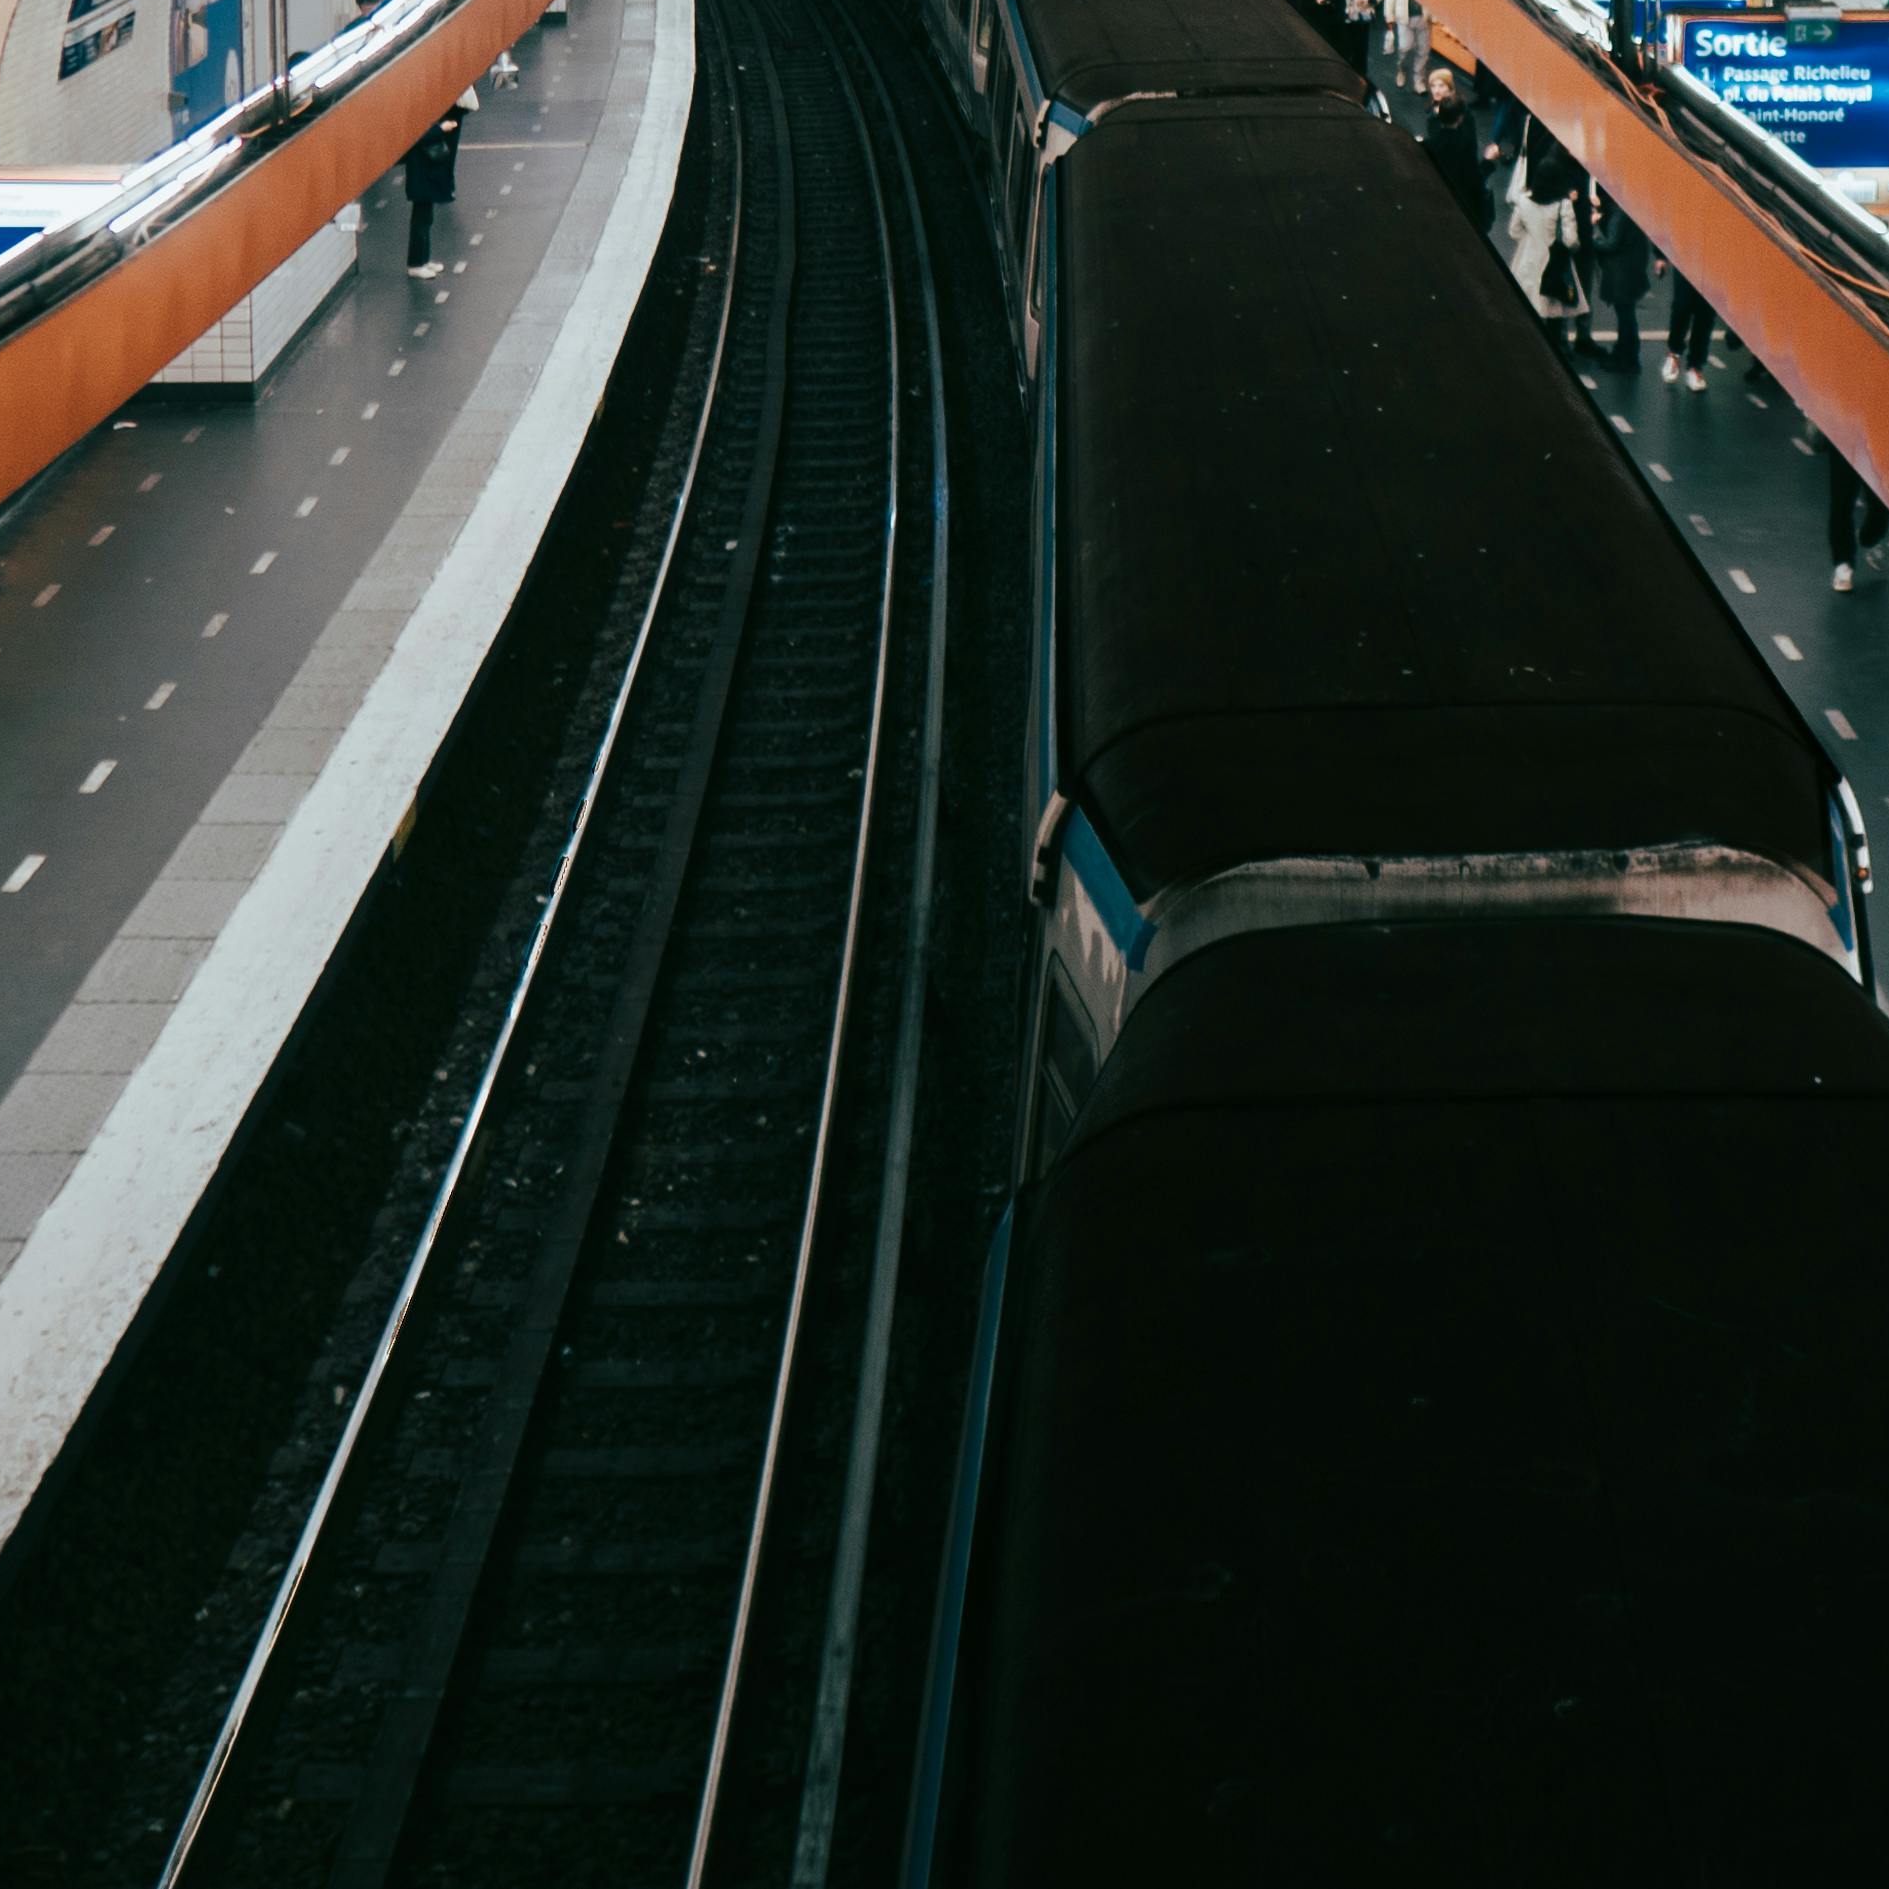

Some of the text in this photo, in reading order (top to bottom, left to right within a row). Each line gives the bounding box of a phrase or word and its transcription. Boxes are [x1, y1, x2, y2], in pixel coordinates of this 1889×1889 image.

[1695, 29, 1788, 57] Sortie
[1723, 65, 1788, 86] Passage
[1793, 65, 1870, 82] Richelieu
[1746, 85, 1768, 103] du
[1772, 85, 1822, 103] Palais
[1824, 84, 1873, 106] Royal
